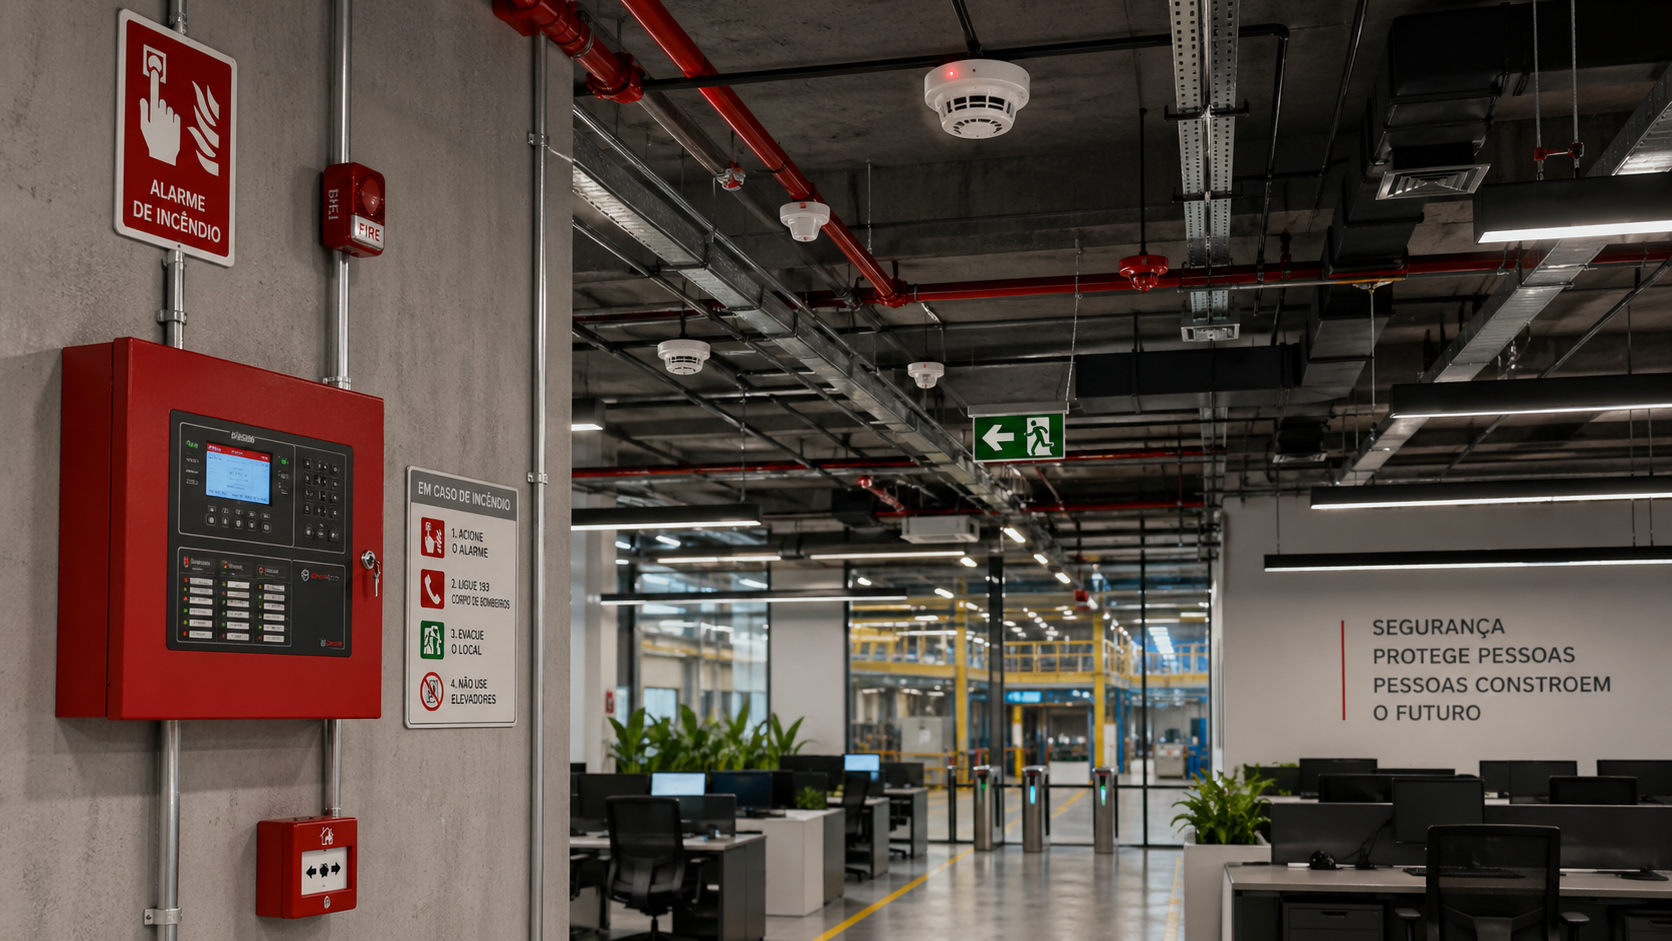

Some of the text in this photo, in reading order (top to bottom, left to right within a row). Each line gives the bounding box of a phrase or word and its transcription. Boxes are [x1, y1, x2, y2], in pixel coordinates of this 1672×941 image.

[150, 179, 206, 212] ALARME
[133, 199, 221, 243] DE INCÊNDIO
[359, 222, 381, 242] FIRE
[418, 481, 511, 510] EM CASO DE INCÊNDIO
[451, 527, 484, 542] 1. ACIONE
[452, 543, 489, 558] O ALARME
[451, 578, 457, 589] 2.
[458, 579, 478, 591] LIGUE
[472, 596, 480, 606] DE
[451, 628, 484, 640] 3. EVACUE
[1372, 618, 1506, 639] SEGURANÇA
[451, 643, 482, 655] O LOCAL
[1373, 646, 1576, 665] PROTEGE PESSOAS
[450, 676, 488, 689] 4. NÃO USE
[1373, 676, 1612, 694] PESSOAS CONSTROEM
[451, 694, 496, 704] ELEVADORES
[1373, 704, 1482, 721] O FUTURO
